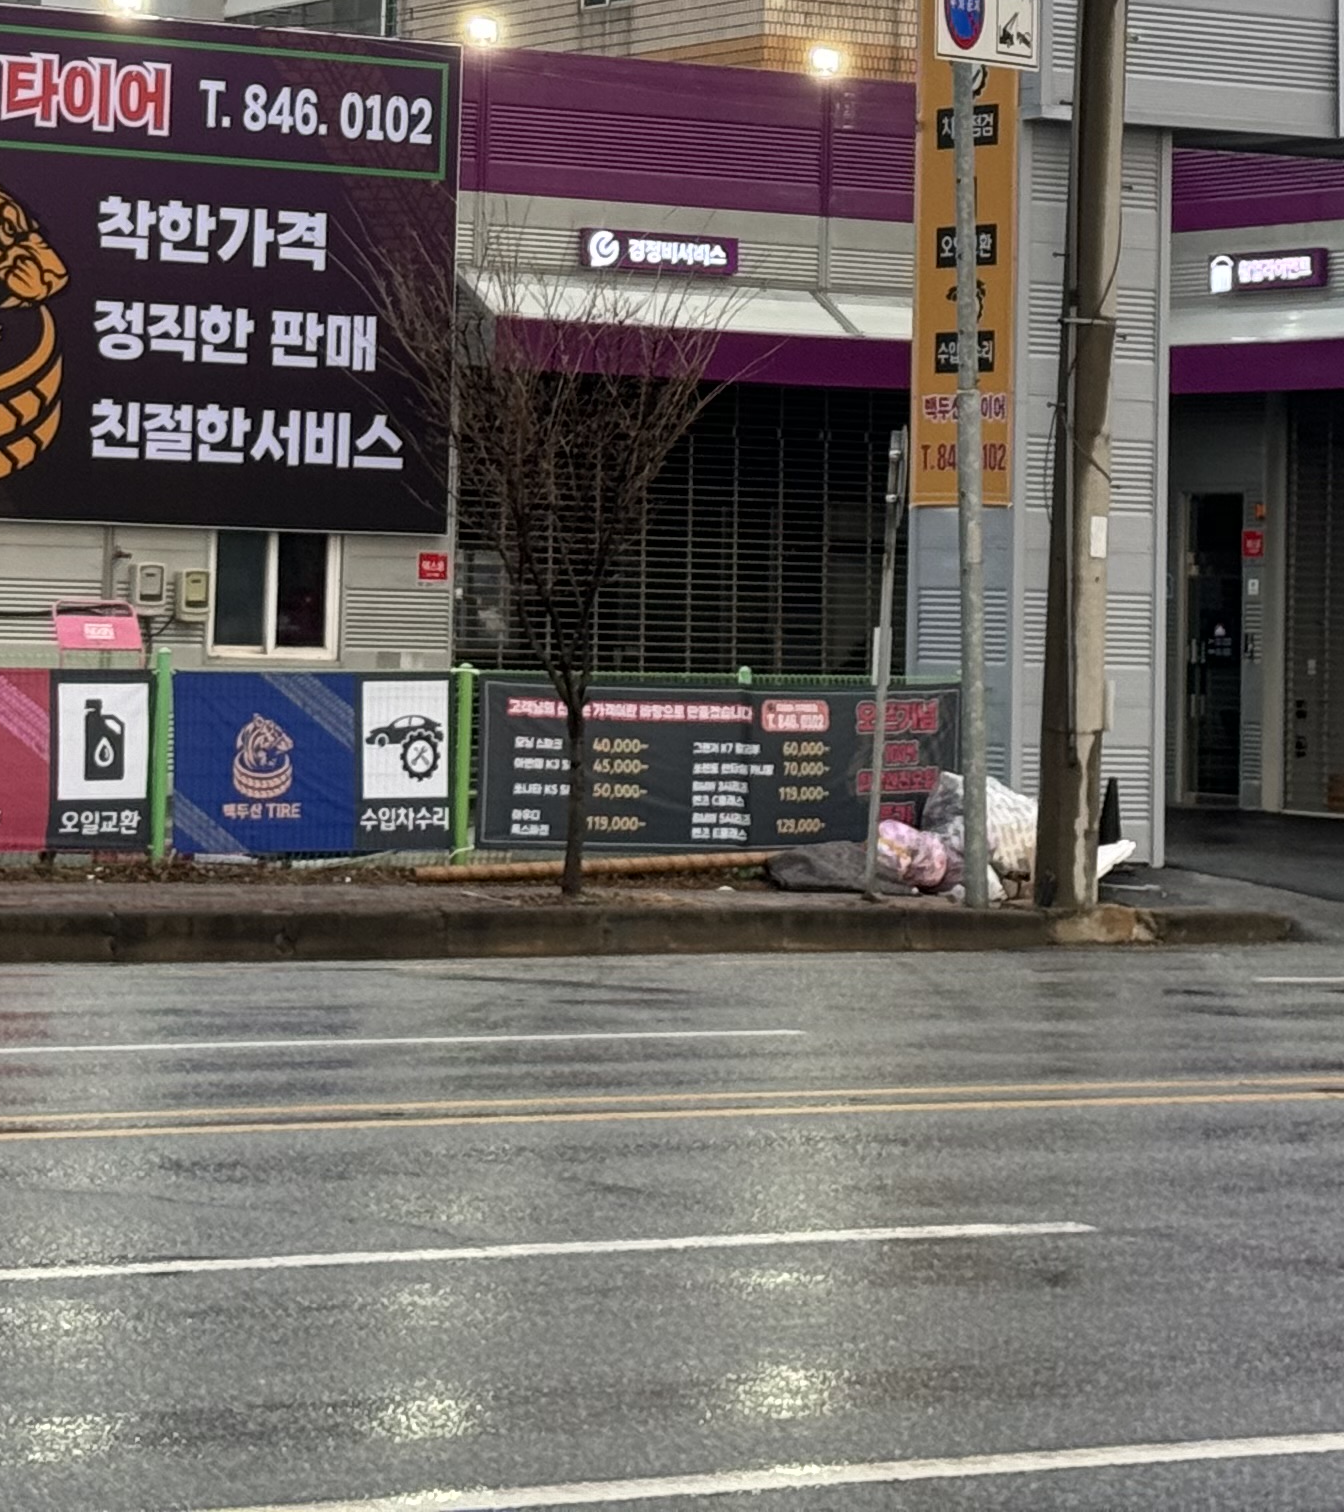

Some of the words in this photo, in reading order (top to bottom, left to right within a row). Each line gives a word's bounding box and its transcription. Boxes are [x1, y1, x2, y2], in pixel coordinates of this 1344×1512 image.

[0, 51, 173, 137] 타이어
[199, 78, 231, 130] T.
[242, 84, 329, 137] 846.
[339, 92, 434, 146] 0102
[97, 194, 329, 272] 착한가격
[628, 238, 728, 267] 경정비서비스
[93, 299, 255, 365] 정직한
[270, 309, 379, 373] 판매
[90, 398, 406, 471] 친절한서비스
[592, 737, 649, 755] 40,000-
[782, 740, 831, 758] 60,000-
[592, 757, 649, 775] 45,000-
[783, 760, 830, 778] 70,000-
[592, 781, 648, 799] 50,000-
[58, 810, 142, 835] 오일교환
[222, 802, 264, 821] 백두산
[266, 802, 302, 819] TIRE
[359, 806, 450, 832] 수입차수리
[585, 814, 647, 832] 119,000-
